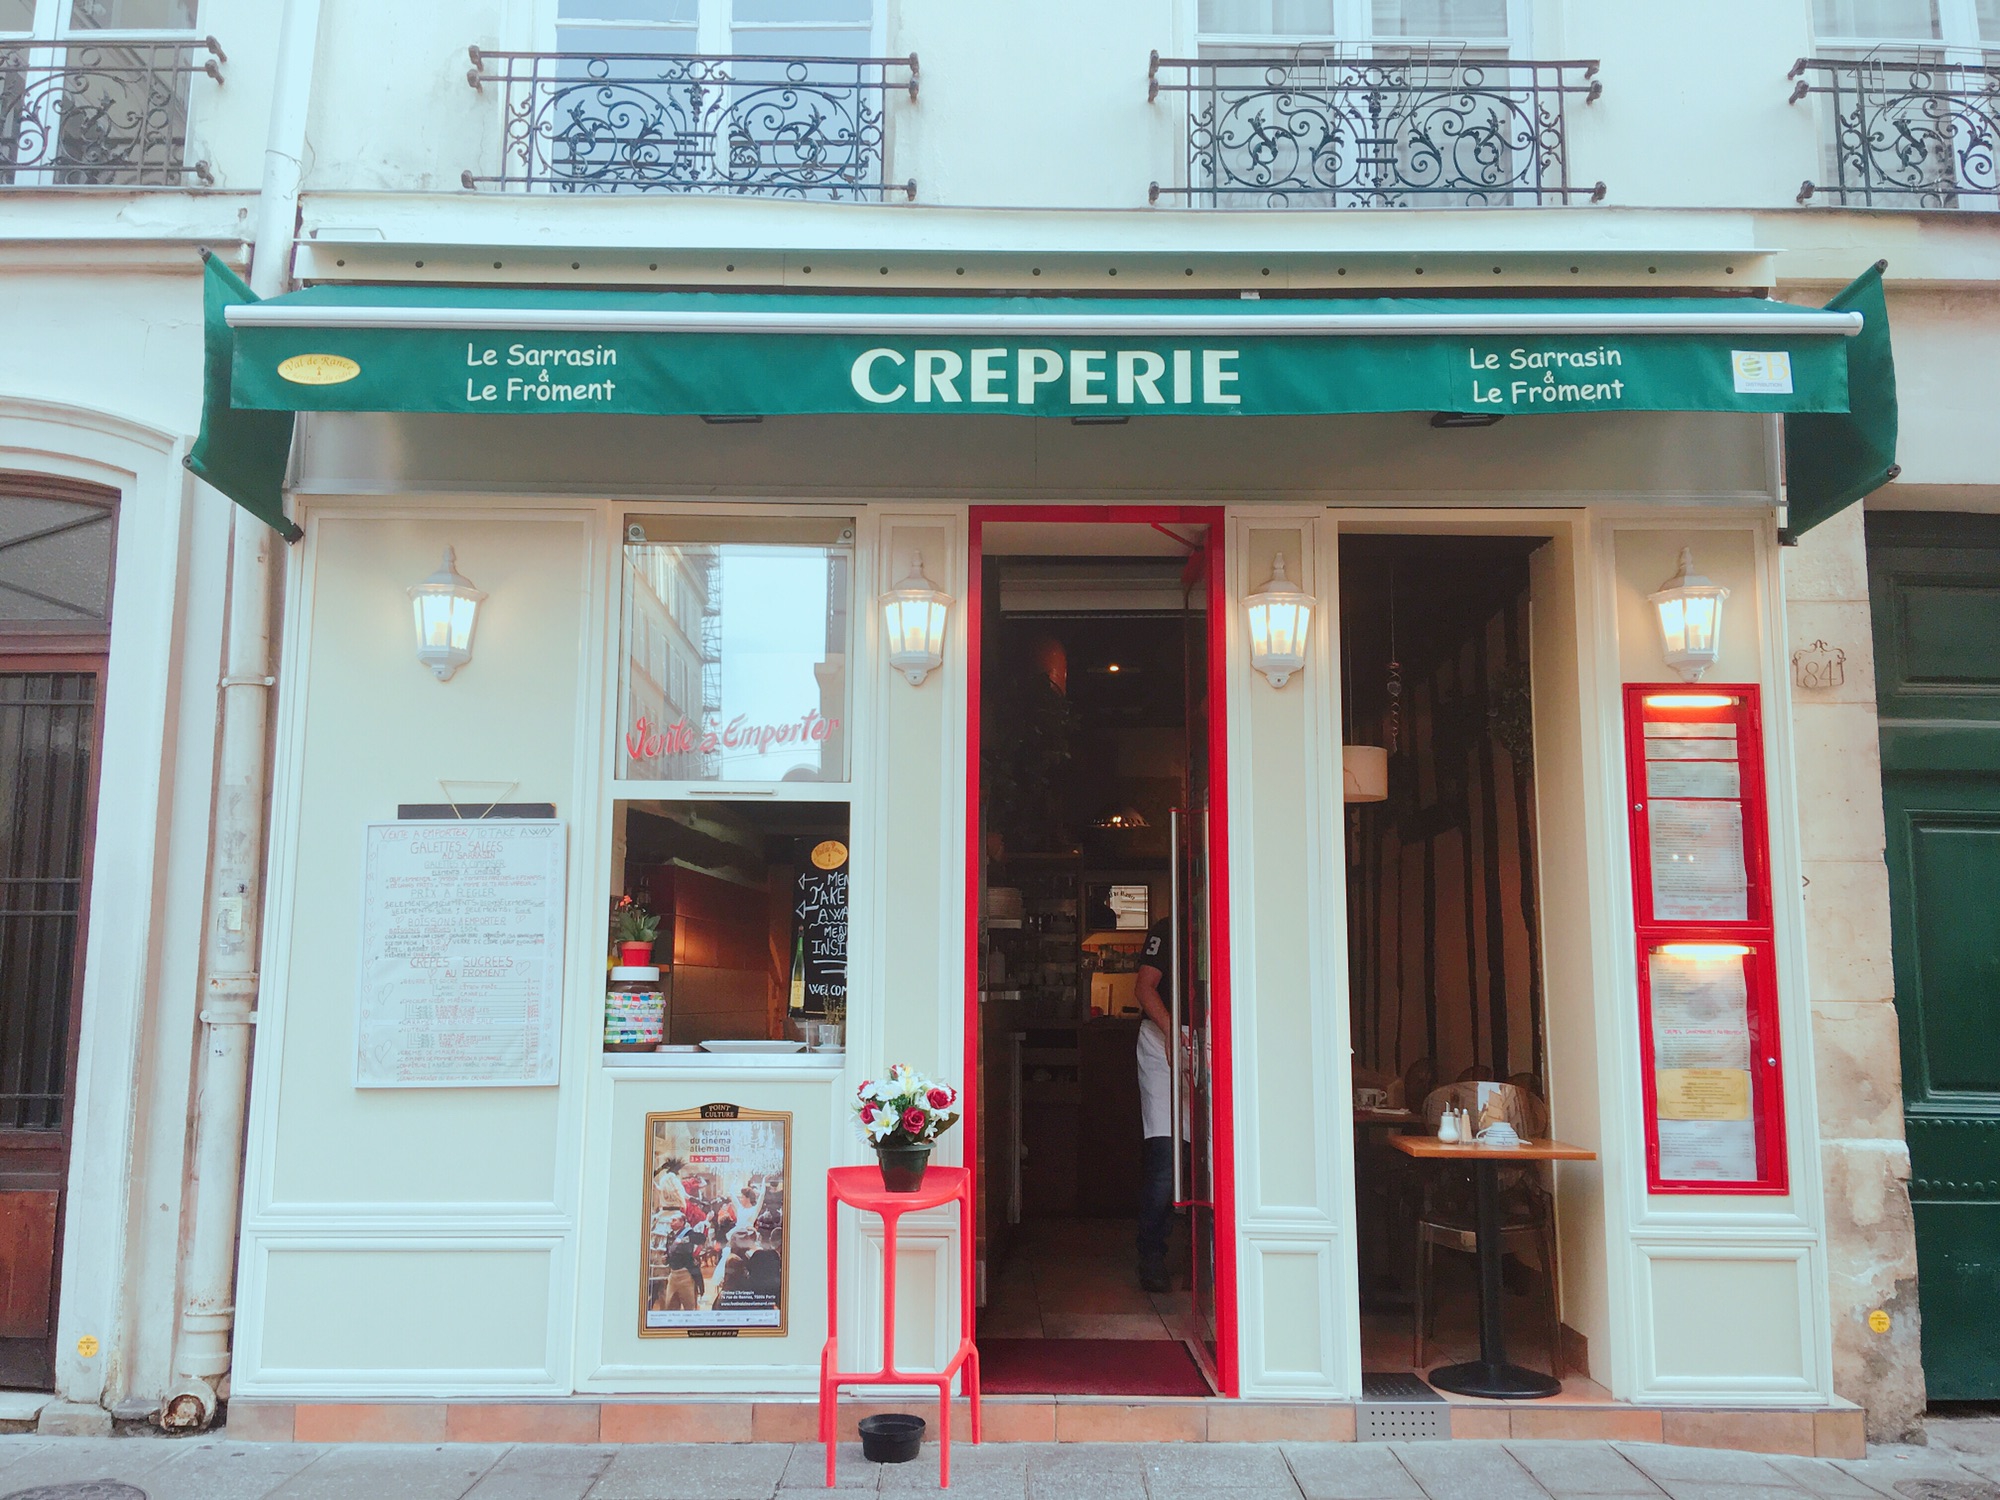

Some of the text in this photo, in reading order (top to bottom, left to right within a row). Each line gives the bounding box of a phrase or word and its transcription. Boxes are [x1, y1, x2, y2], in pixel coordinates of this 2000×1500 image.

[467, 342, 617, 367] Le Sarrasin
[1469, 346, 1622, 370] Le Sarrasin
[285, 356, 354, 372] Val de Rance
[538, 369, 549, 382] &
[851, 347, 1242, 405] CREPERIE
[1543, 370, 1555, 383] &
[467, 378, 616, 402] Le Froment
[1473, 379, 1625, 404] Le Froment
[1803, 660, 1837, 689] 84
[625, 708, 840, 762] Vente à Emporter
[379, 828, 409, 841] VENTE
[414, 830, 421, 840] A
[423, 828, 468, 839] EMPORTER
[488, 827, 515, 839] TAKE
[410, 841, 462, 854] GALETTES
[442, 850, 496, 860] AU SARRASIN
[424, 860, 459, 870] GALETTES
[469, 859, 506, 869] COMPOSER
[410, 888, 437, 900] PRIX
[456, 888, 497, 899] REGLER
[810, 883, 845, 906] TAKE
[408, 914, 457, 927] BOISSONS
[465, 916, 507, 926] EMPORTER
[811, 939, 848, 956] INSI
[1146, 936, 1162, 956] 3
[462, 956, 514, 968] SUCREES
[445, 968, 509, 978] AU FROMENT
[708, 1104, 731, 1112] POINT
[690, 1136, 731, 1145] du cinéma
[690, 1145, 731, 1153] allemand
